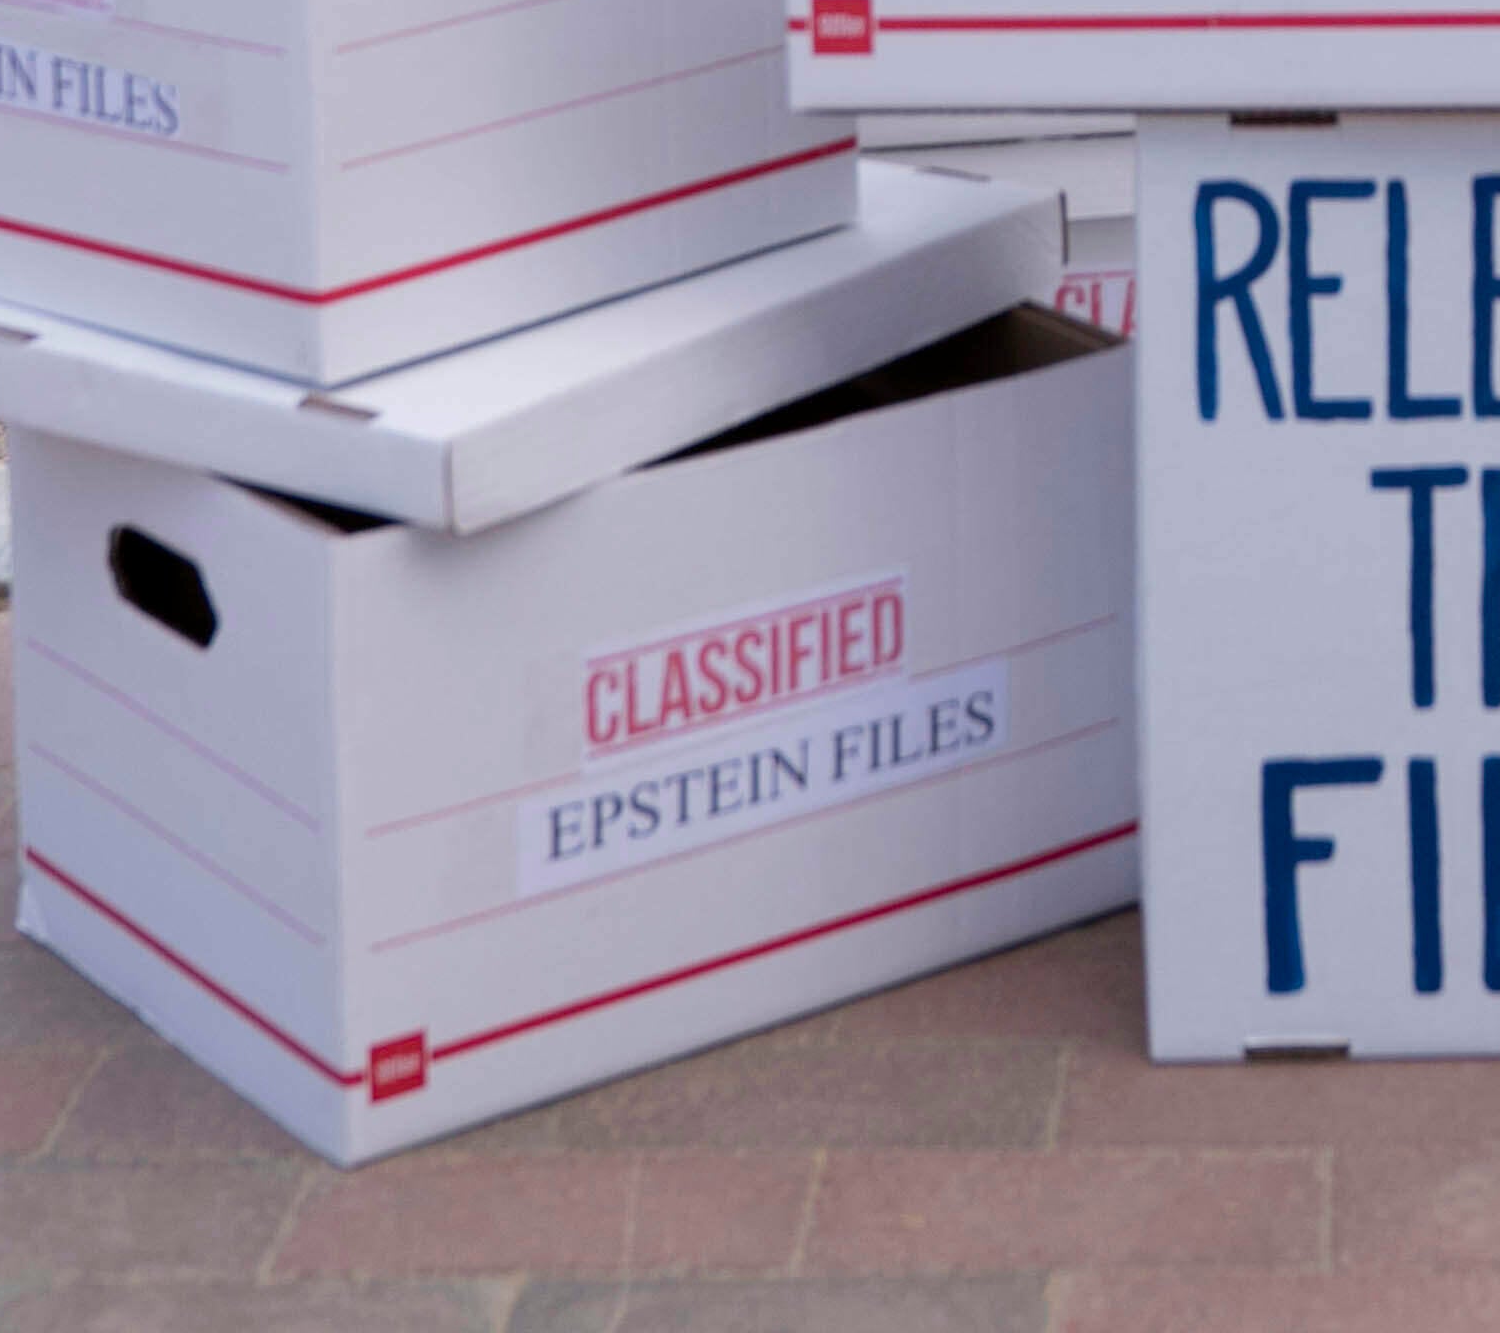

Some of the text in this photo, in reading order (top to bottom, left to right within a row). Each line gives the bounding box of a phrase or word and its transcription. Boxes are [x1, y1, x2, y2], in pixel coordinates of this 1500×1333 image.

[50, 56, 181, 136] FILES
[586, 592, 906, 744] CLASSIFIED
[546, 689, 998, 863] EPSTEIN FILES
